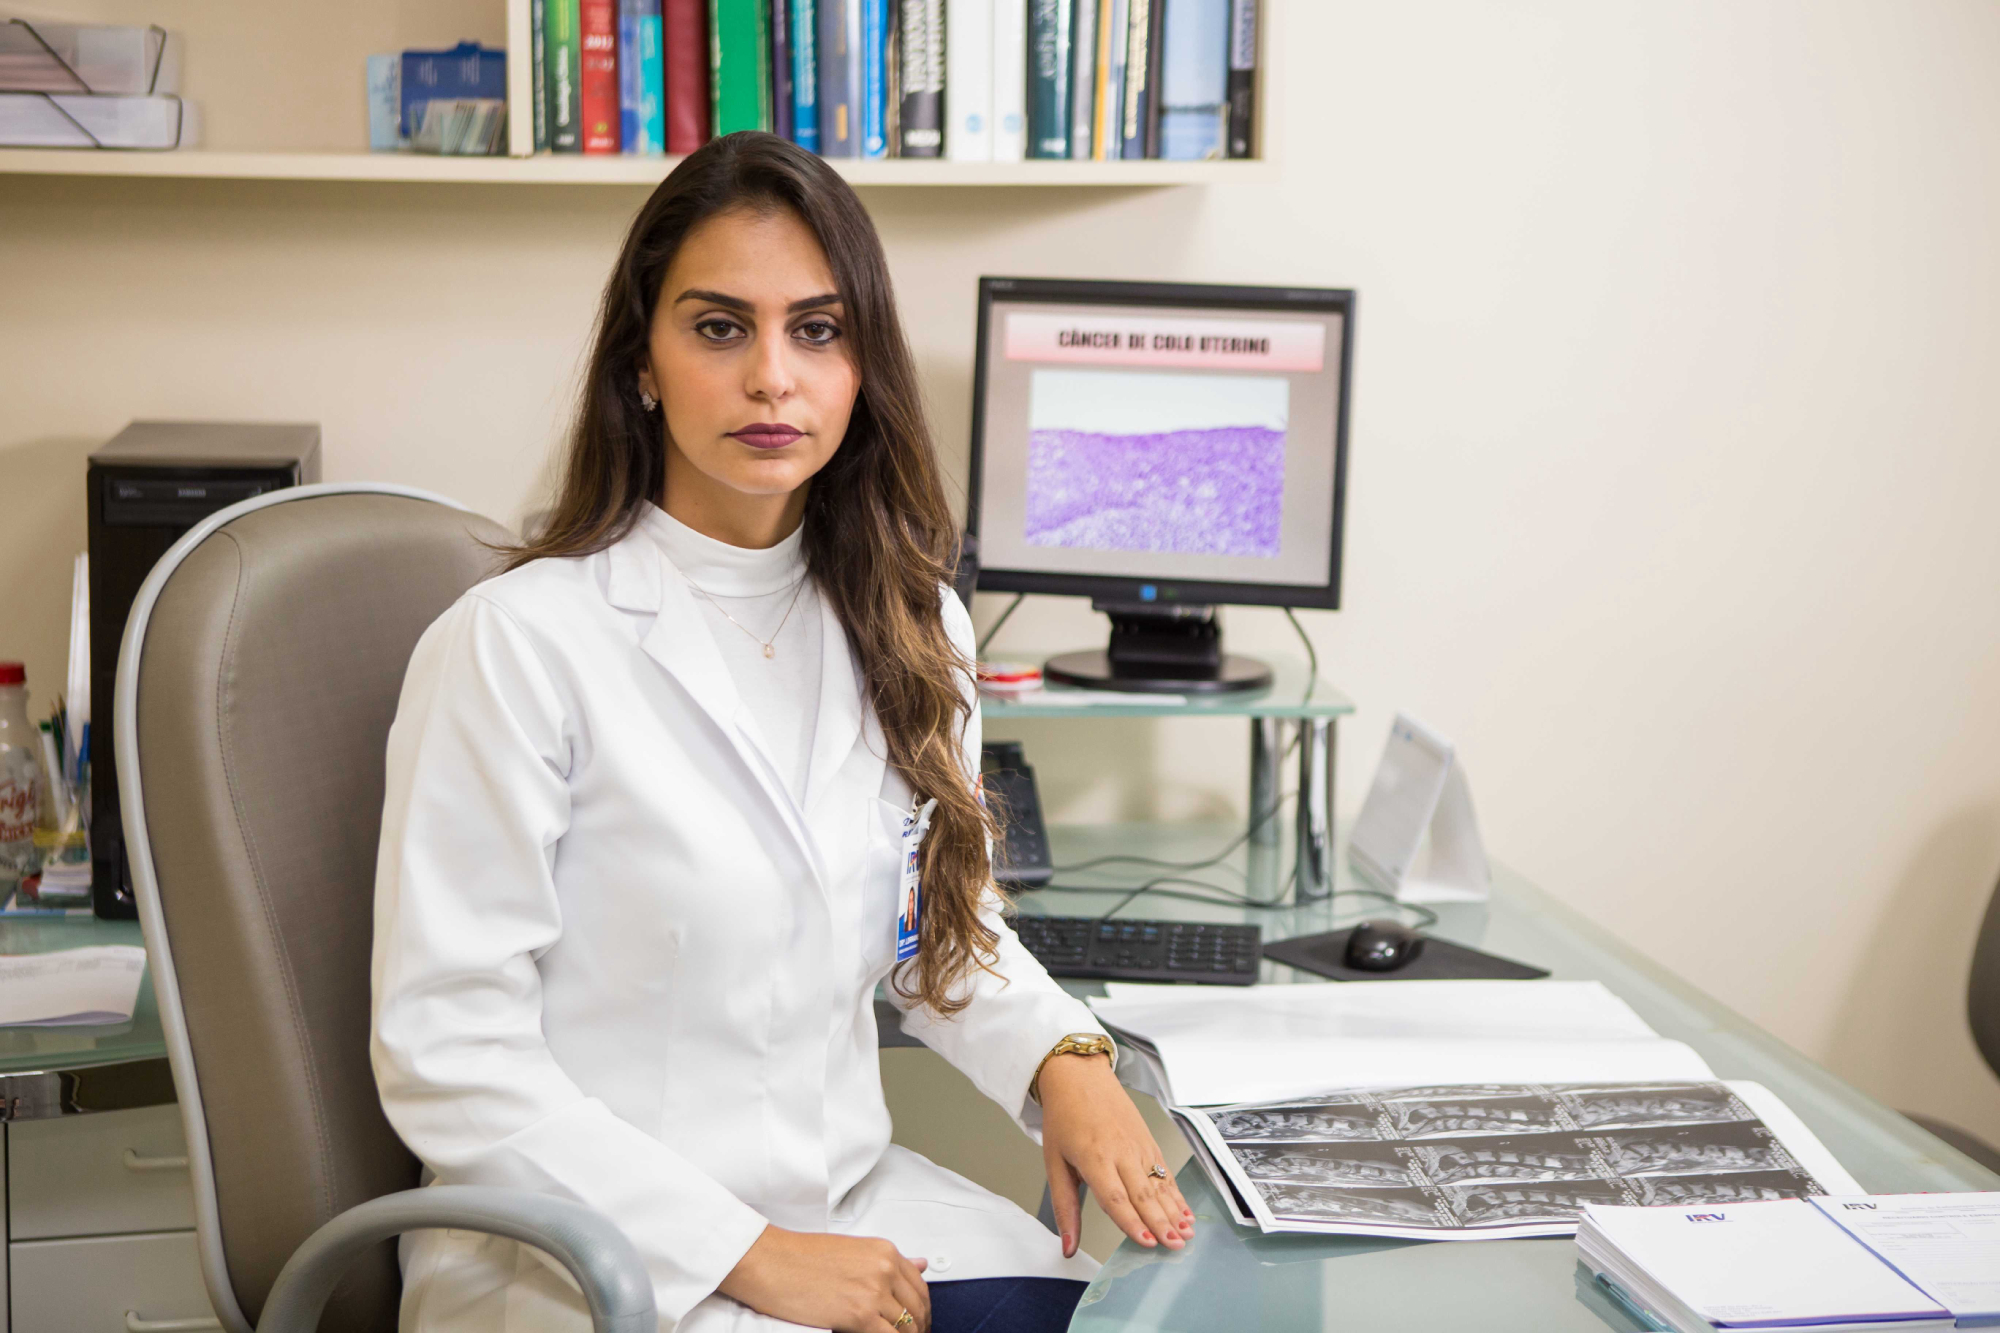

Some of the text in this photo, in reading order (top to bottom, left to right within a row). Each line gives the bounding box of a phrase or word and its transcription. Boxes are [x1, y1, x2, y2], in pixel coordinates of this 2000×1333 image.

[1128, 333, 1146, 350] DE
[1153, 334, 1194, 352] COLO
[1200, 336, 1270, 356] UTERINO
[1842, 1202, 1877, 1211] IRV
[1685, 1213, 1726, 1222] IRV
